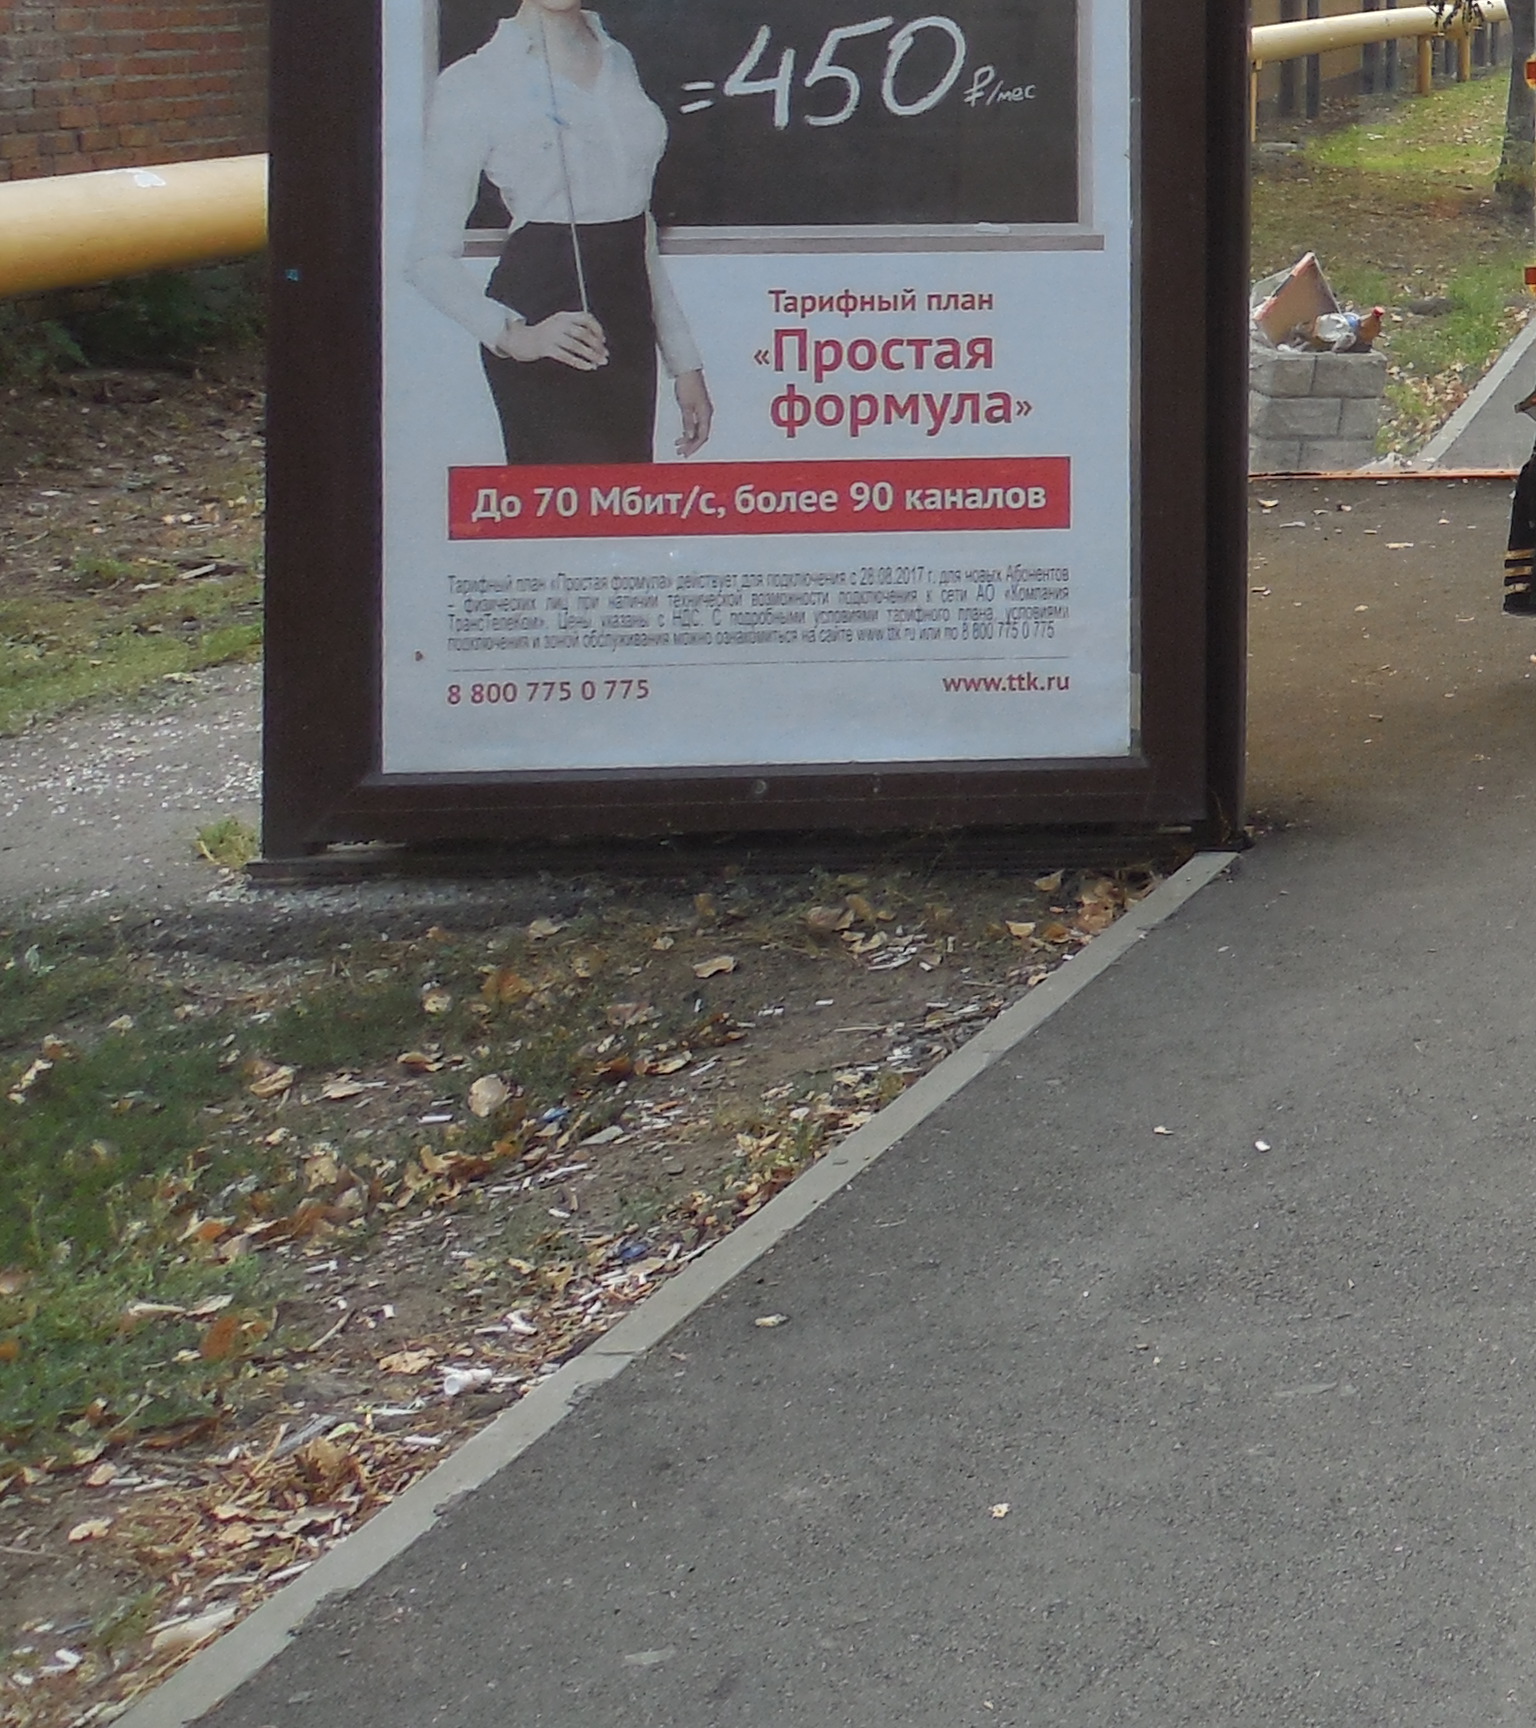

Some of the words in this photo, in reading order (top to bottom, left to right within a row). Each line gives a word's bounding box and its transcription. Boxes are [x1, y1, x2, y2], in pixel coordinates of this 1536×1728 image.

[768, 289, 916, 319] Тарифный
[927, 292, 994, 311] план
[753, 328, 993, 383] «Простая
[770, 383, 1033, 438] формула»
[471, 487, 522, 522] До
[533, 486, 578, 518] 70
[590, 483, 726, 520] Мбит/с,
[735, 484, 838, 514] более
[849, 481, 893, 512] 90
[904, 483, 1047, 511] каналов
[975, 584, 996, 602] АО
[447, 684, 461, 705] 8
[471, 682, 517, 704] 800
[527, 681, 572, 702] 775
[581, 680, 596, 701] 0
[604, 679, 650, 699] 775
[943, 671, 1070, 693] www.ttk.ru
